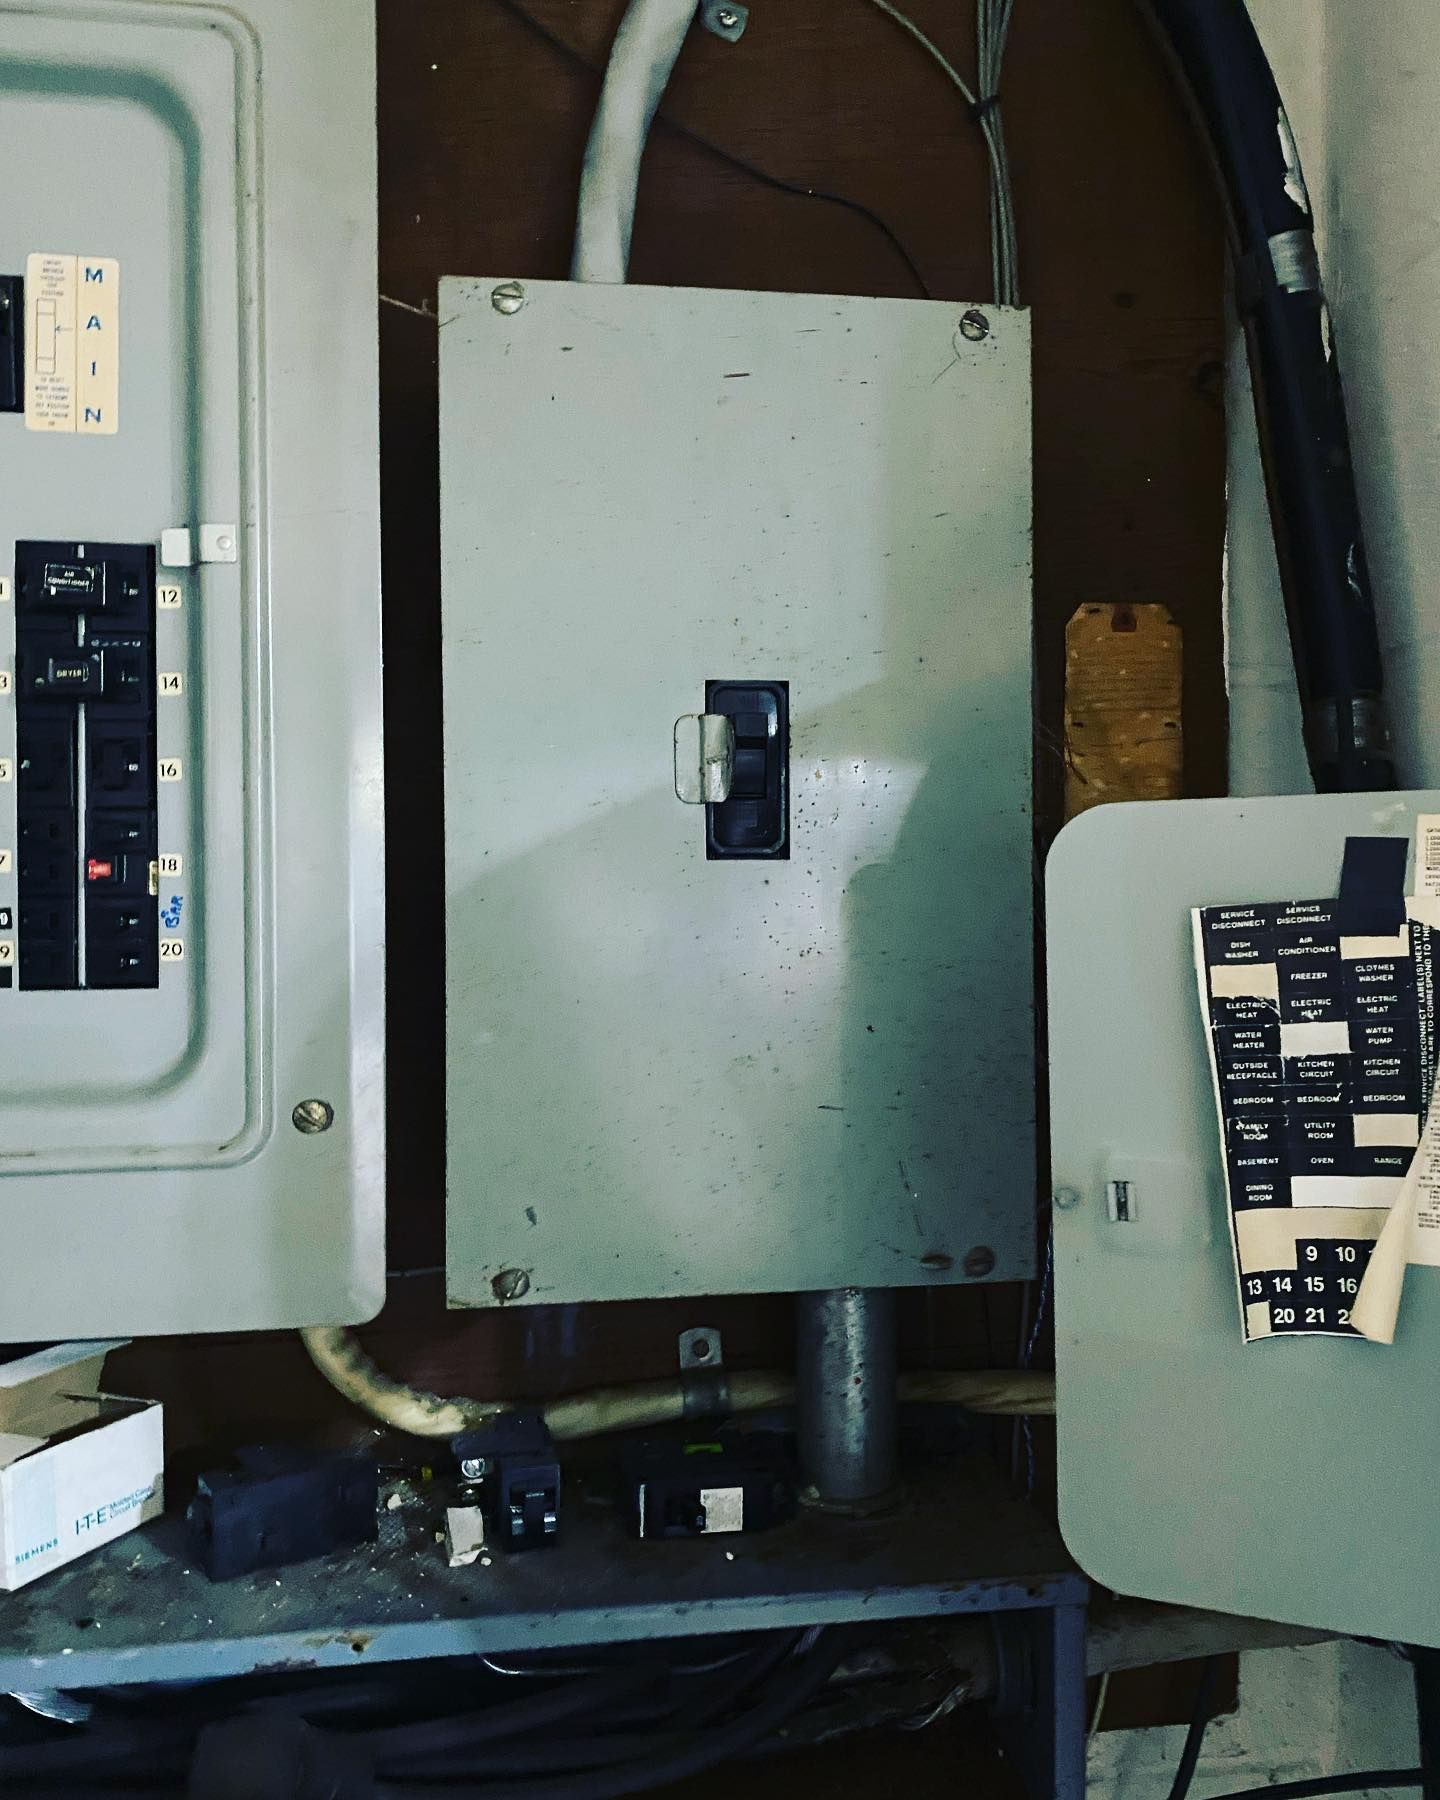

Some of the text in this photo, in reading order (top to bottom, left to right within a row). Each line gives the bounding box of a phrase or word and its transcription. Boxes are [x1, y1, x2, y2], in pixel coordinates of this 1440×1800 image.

[85, 267, 103, 423] MAIN
[161, 591, 178, 604] 12
[56, 669, 82, 678] DRYER
[163, 676, 179, 690] 14
[160, 763, 177, 777] 16
[161, 858, 177, 871] 18
[1285, 905, 1321, 915] SERVICE
[1220, 910, 1255, 920] SERVICE
[1211, 919, 1266, 930] DISCONNECT
[1276, 914, 1332, 926] DISCONNECT
[1413, 925, 1421, 937] TO
[1298, 936, 1313, 944] AIR
[1230, 941, 1251, 949] DISH
[1423, 943, 1431, 955] TO
[161, 943, 182, 957] 20
[1278, 946, 1336, 956] CONDITIONER
[1414, 940, 1423, 962] NEXT
[1224, 951, 1259, 959] WASHER
[1355, 964, 1395, 973] CLOTHES
[1290, 972, 1328, 981] FREEZER
[1358, 974, 1394, 983] WASHER
[1416, 964, 1425, 1003] LABEL(S)
[1424, 958, 1434, 1018] CORRESPOND
[1290, 998, 1332, 1008] ELECTRIC
[1357, 995, 1398, 1004] ELECTRIC
[1226, 1001, 1266, 1010] ELECTRIC
[1366, 1005, 1389, 1014] HEAT
[1236, 1011, 1258, 1019] HEAT
[1301, 1009, 1323, 1018] HEAT
[1365, 1026, 1394, 1034] WATER
[1427, 1020, 1434, 1032] TO
[1234, 1031, 1262, 1039] WATER
[1419, 1008, 1428, 1065] DISCONNECT
[1232, 1041, 1265, 1049] HEATER
[1368, 1037, 1393, 1045] PUMP
[1232, 1061, 1269, 1070] OUTSIDE
[1297, 1060, 1335, 1068] KITCHEN
[1363, 1058, 1401, 1067] KITCHEN
[1226, 1071, 1278, 1080] RECEPTACLE
[1299, 1070, 1334, 1078] CIRCUIT
[1365, 1068, 1400, 1077] CIRCUIT
[1233, 1096, 1274, 1105] BEDROOM
[1297, 1095, 1340, 1103] BEDROOM
[1362, 1094, 1406, 1102] BEDROOM
[1243, 1133, 1269, 1141] ROOM
[1237, 1157, 1279, 1166] BASEMENT
[1374, 1157, 1402, 1165] RANGE
[1245, 1184, 1274, 1192] DINING
[1248, 1194, 1273, 1202] ROOM
[1305, 1246, 1318, 1261] 9
[1335, 1246, 1356, 1262] 10
[1246, 1279, 1262, 1295] 13
[1272, 1277, 1292, 1292] 14
[1304, 1276, 1324, 1292] 15
[1337, 1278, 1358, 1293] 16
[1274, 1308, 1295, 1323] 20
[1305, 1307, 1325, 1323] 21
[1337, 1309, 1350, 1324] 2
[15, 1538, 59, 1565] SIEMENS
